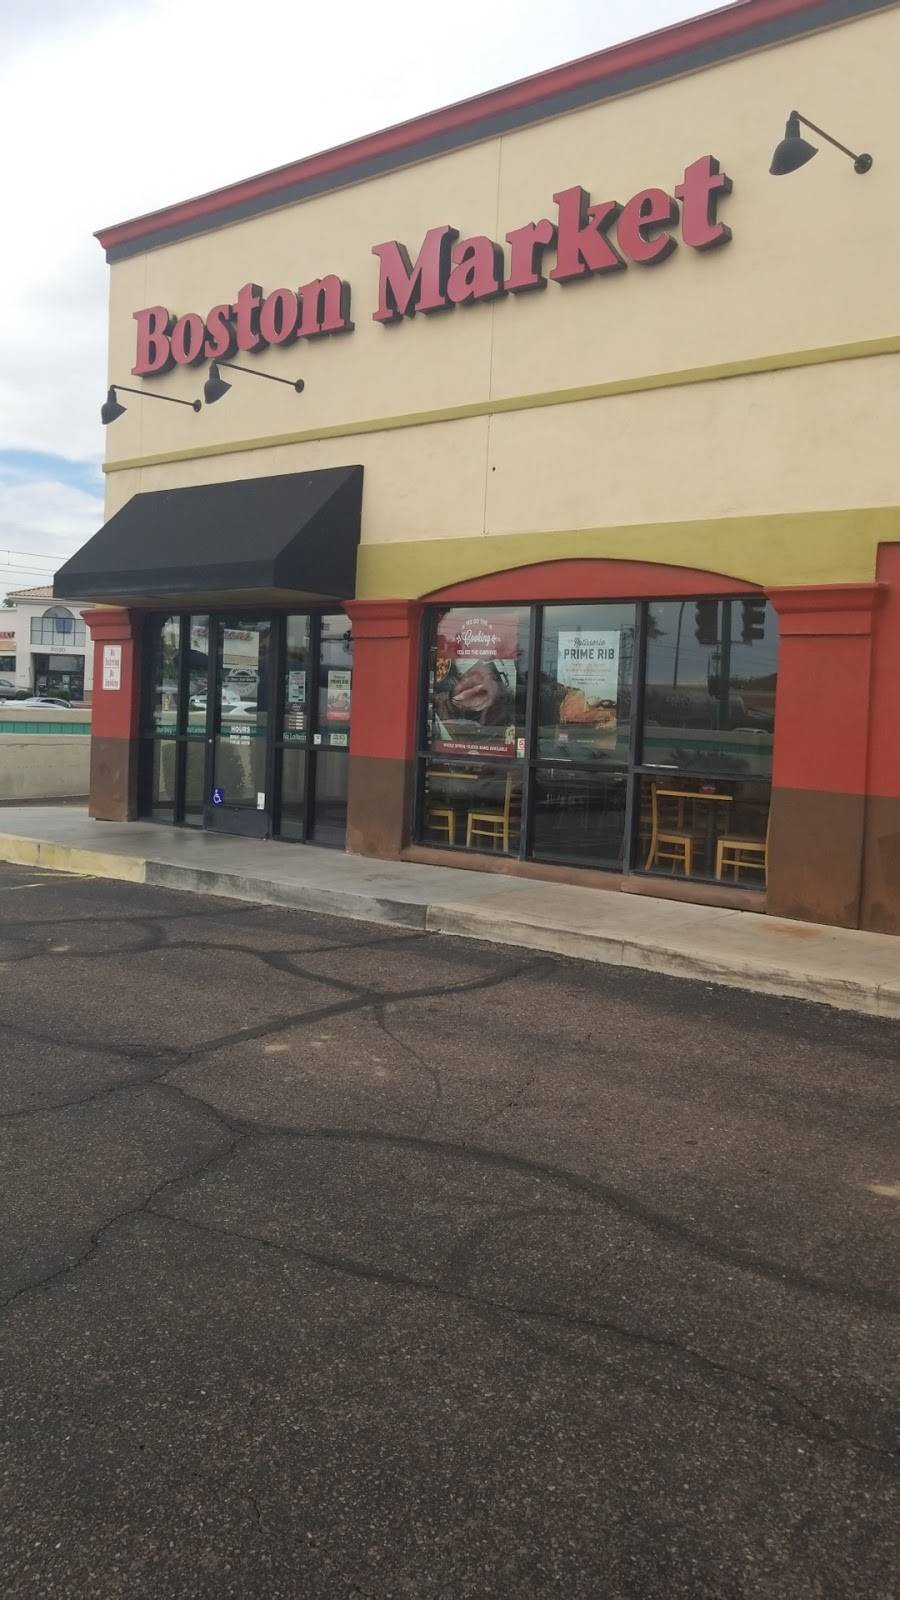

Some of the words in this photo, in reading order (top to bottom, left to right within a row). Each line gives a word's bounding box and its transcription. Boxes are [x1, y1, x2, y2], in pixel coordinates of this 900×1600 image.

[131, 274, 353, 377] Boston
[371, 154, 731, 324] Market
[563, 648, 594, 660] PRIME
[597, 648, 615, 660] RIB
[231, 726, 251, 734] HOURS
